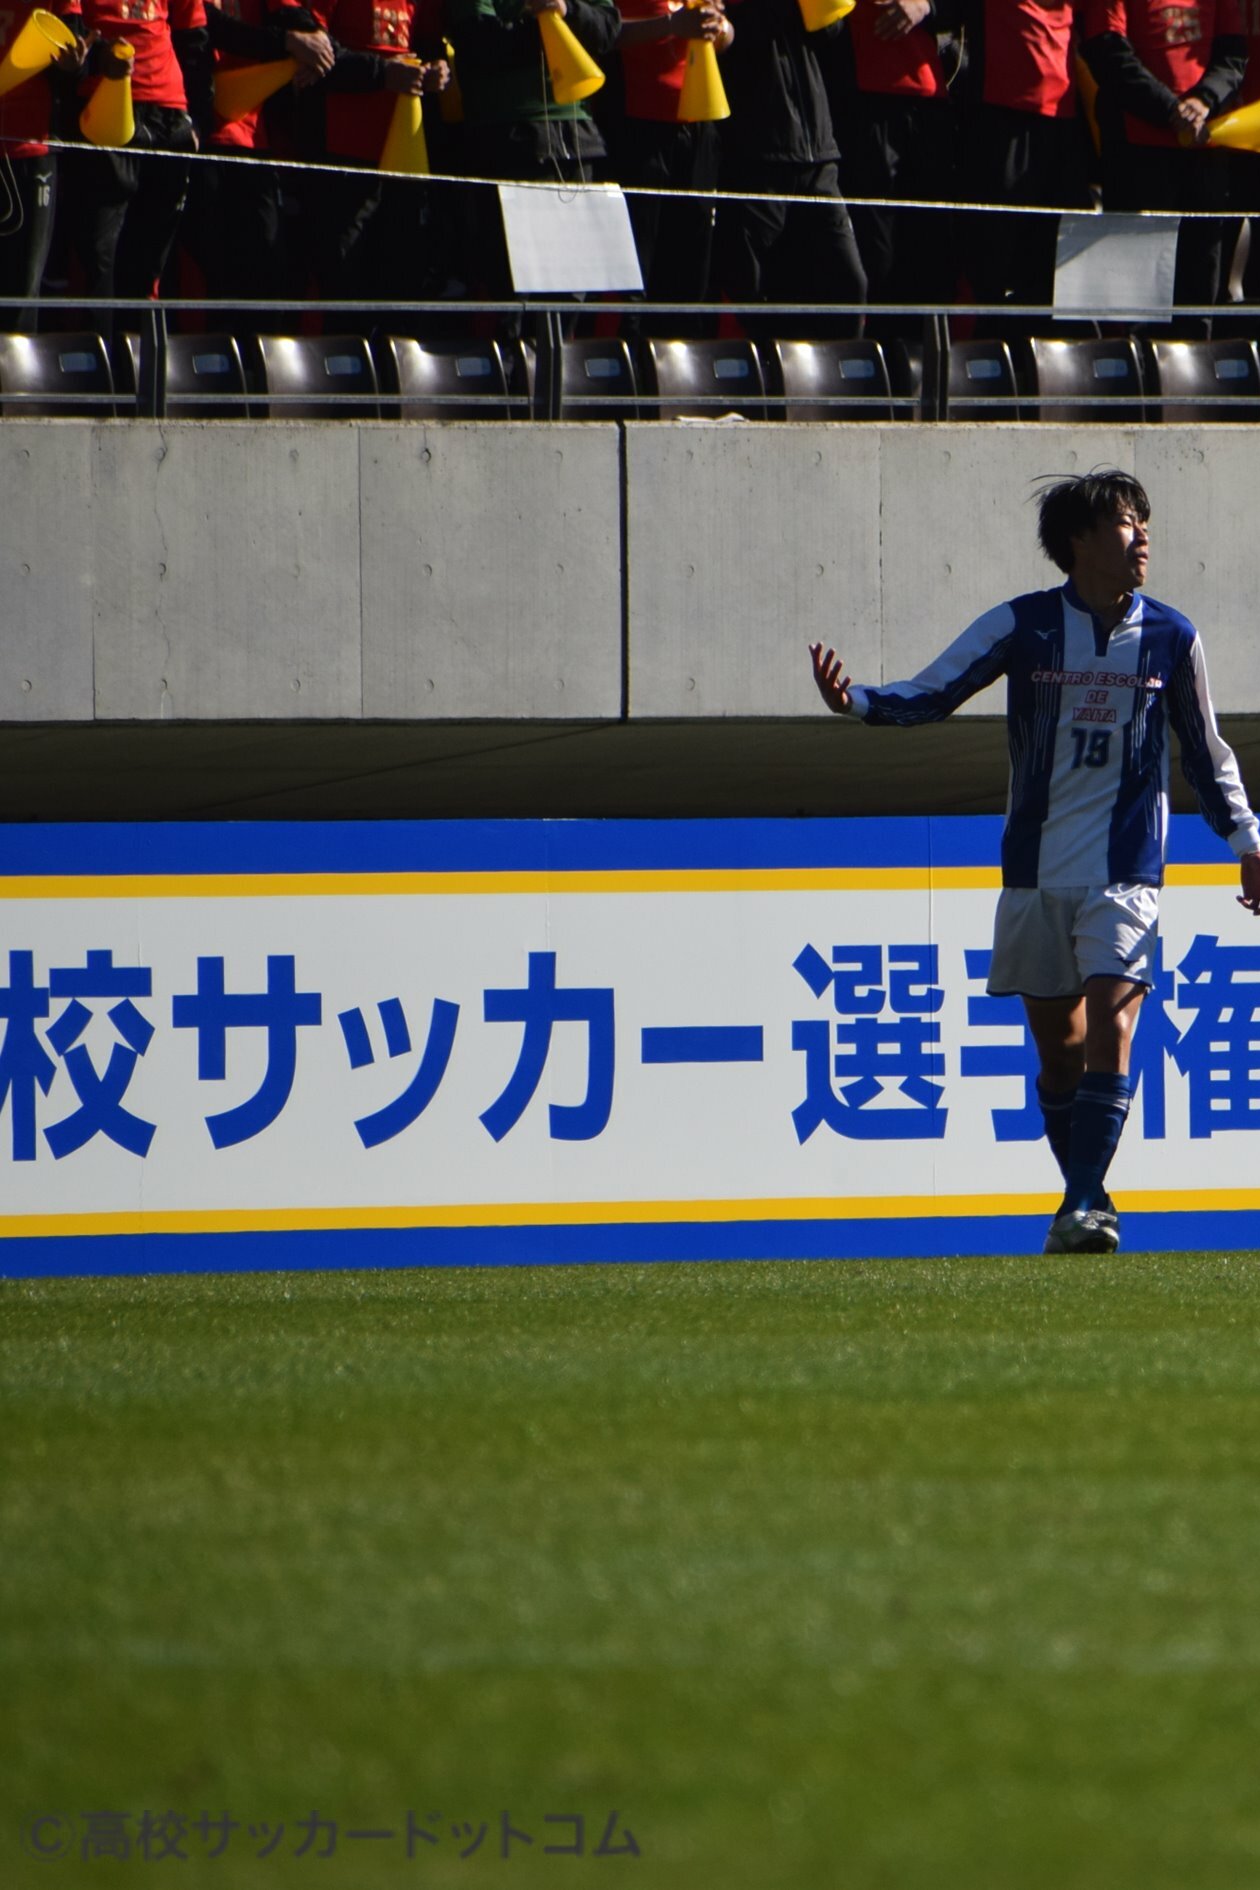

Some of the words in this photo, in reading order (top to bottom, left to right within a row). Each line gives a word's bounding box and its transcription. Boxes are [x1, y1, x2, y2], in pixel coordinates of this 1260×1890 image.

[1030, 670, 1094, 687] CENTRO
[1084, 690, 1109, 705] DE
[1072, 707, 1117, 724] YAITA
